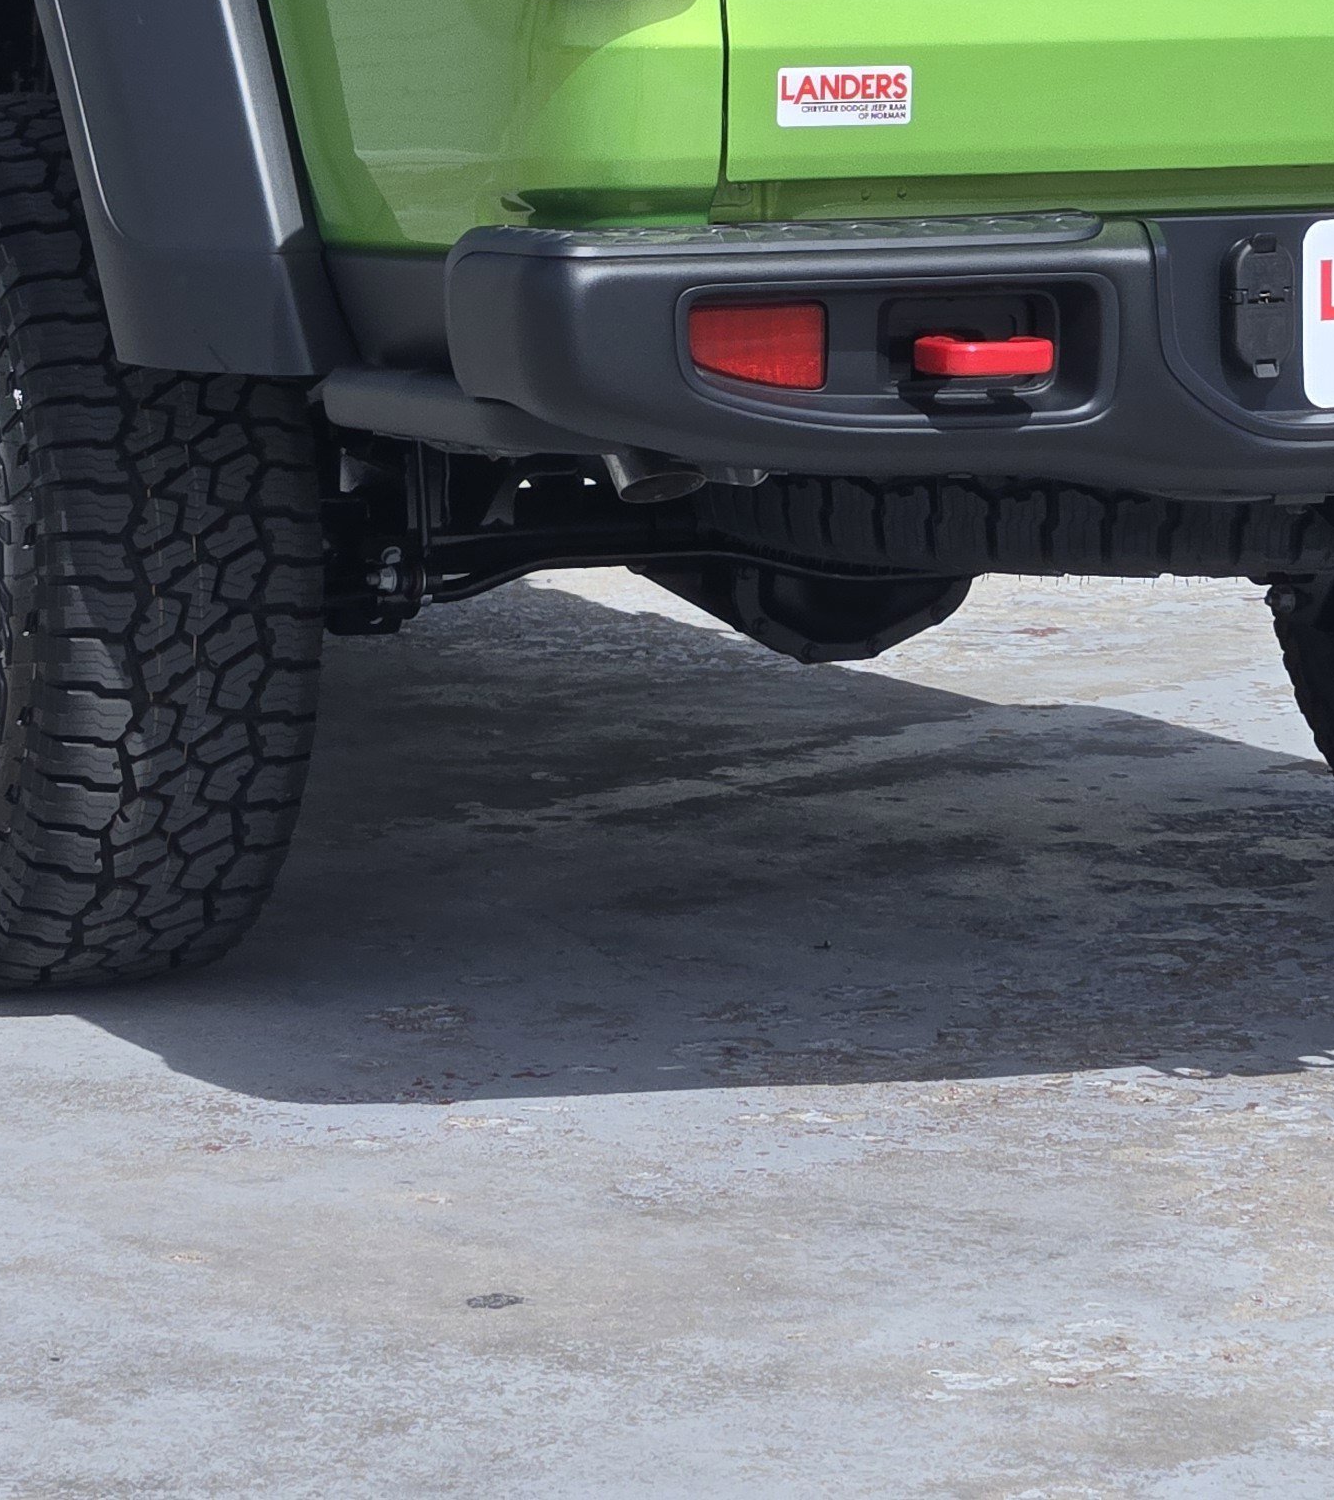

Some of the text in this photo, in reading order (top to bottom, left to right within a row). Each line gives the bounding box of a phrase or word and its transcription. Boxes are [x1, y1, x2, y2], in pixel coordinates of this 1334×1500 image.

[780, 73, 908, 105] LANDERS
[801, 105, 838, 113] CHRYSLER
[840, 104, 868, 112] DODGE
[889, 103, 906, 111] RAM
[871, 111, 906, 119] NORMAN
